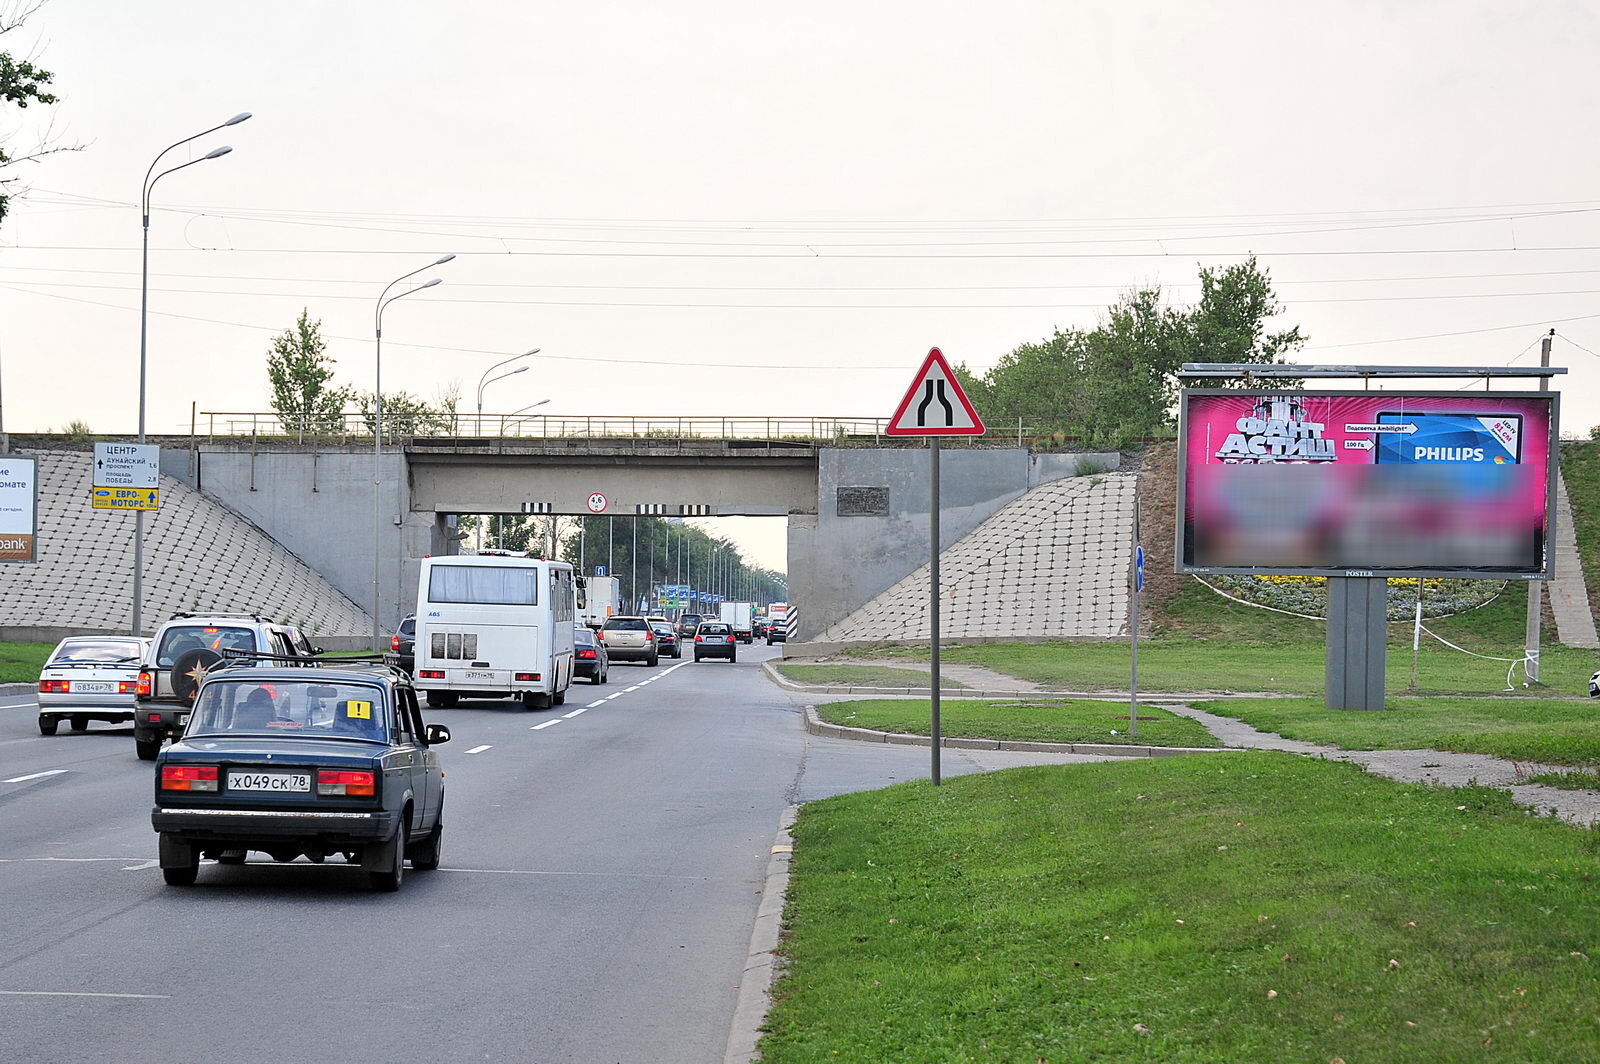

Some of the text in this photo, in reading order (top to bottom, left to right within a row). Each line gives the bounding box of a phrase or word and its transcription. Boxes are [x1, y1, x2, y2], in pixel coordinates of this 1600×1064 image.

[1236, 418, 1325, 439] ФАНТ
[1494, 422, 1504, 434] 81
[106, 446, 137, 455] ЦЕНТР
[1219, 433, 1337, 457] АСТИШ
[1414, 446, 1485, 462] PHILIPS
[106, 457, 146, 465] ДУНАЙСКИЙ
[111, 499, 145, 508] МОТОРС
[292, 776, 306, 787] 78
